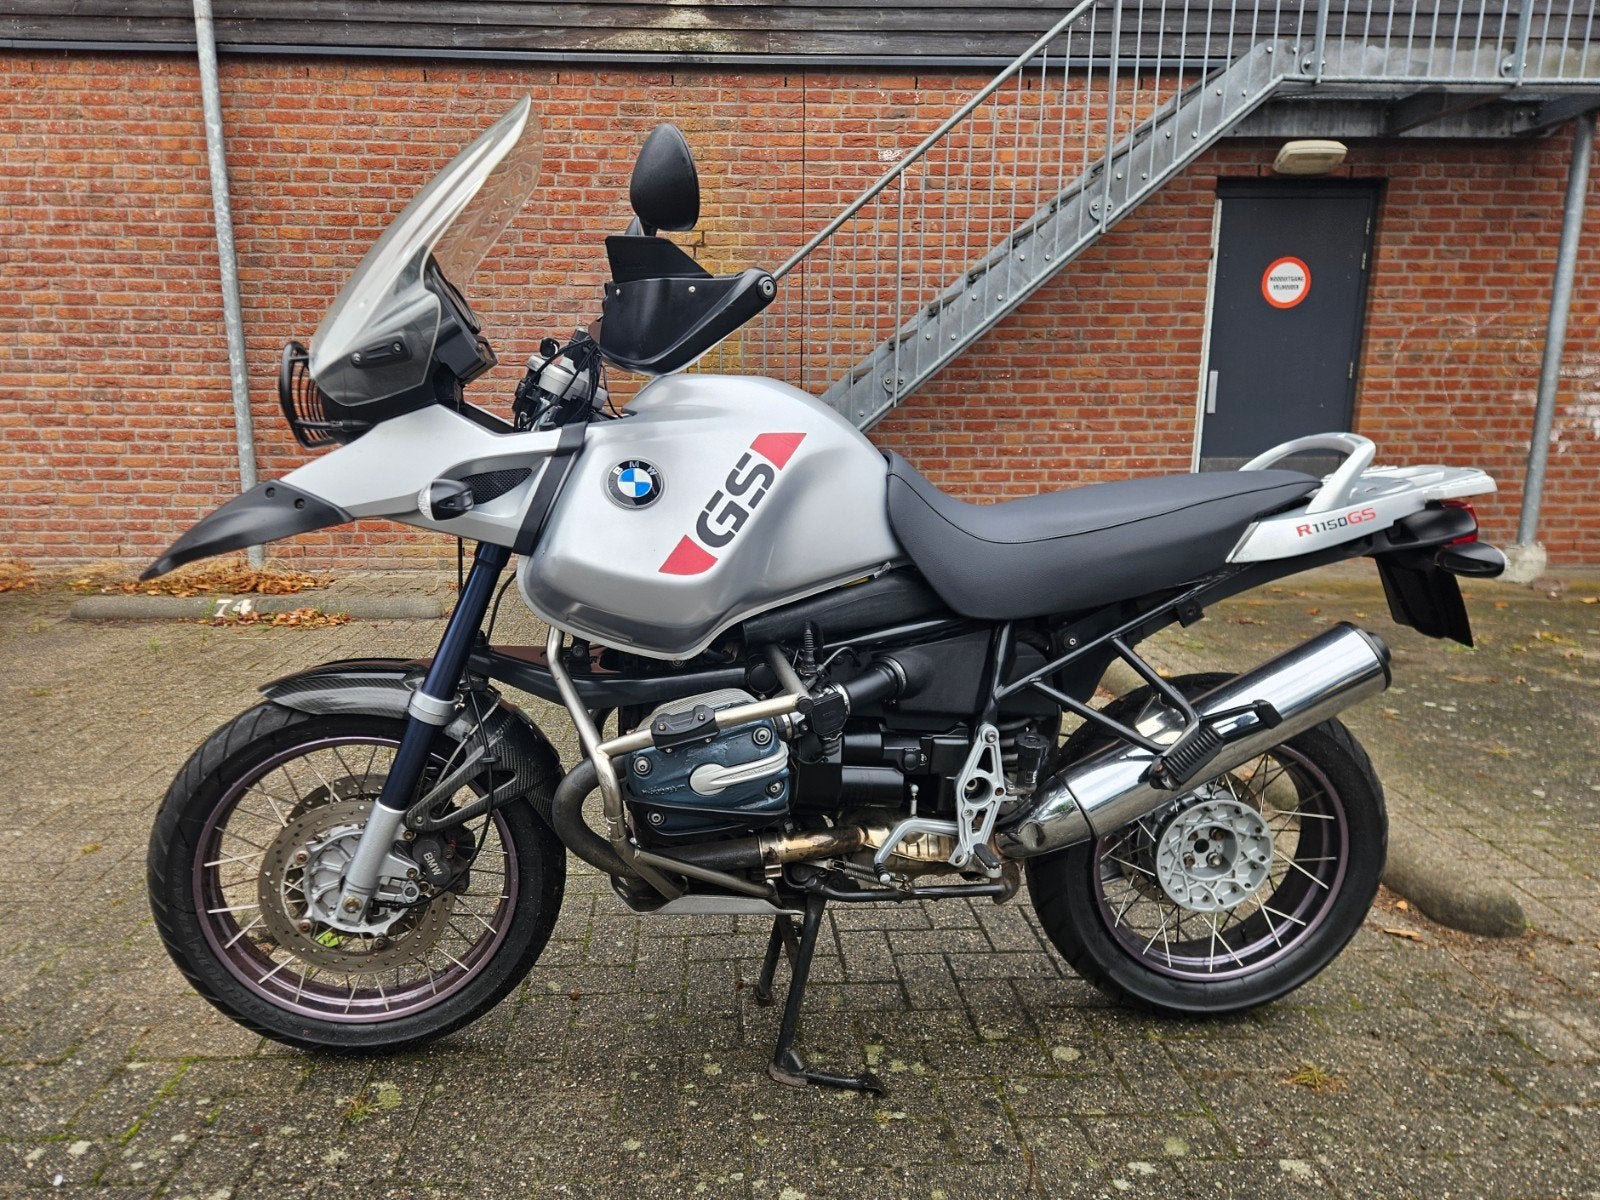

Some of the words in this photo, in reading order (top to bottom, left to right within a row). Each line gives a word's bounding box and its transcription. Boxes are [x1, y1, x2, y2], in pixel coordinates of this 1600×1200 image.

[612, 460, 658, 476] BMW
[696, 452, 775, 548] GS
[214, 599, 253, 617] 74
[423, 852, 443, 876] BMW
